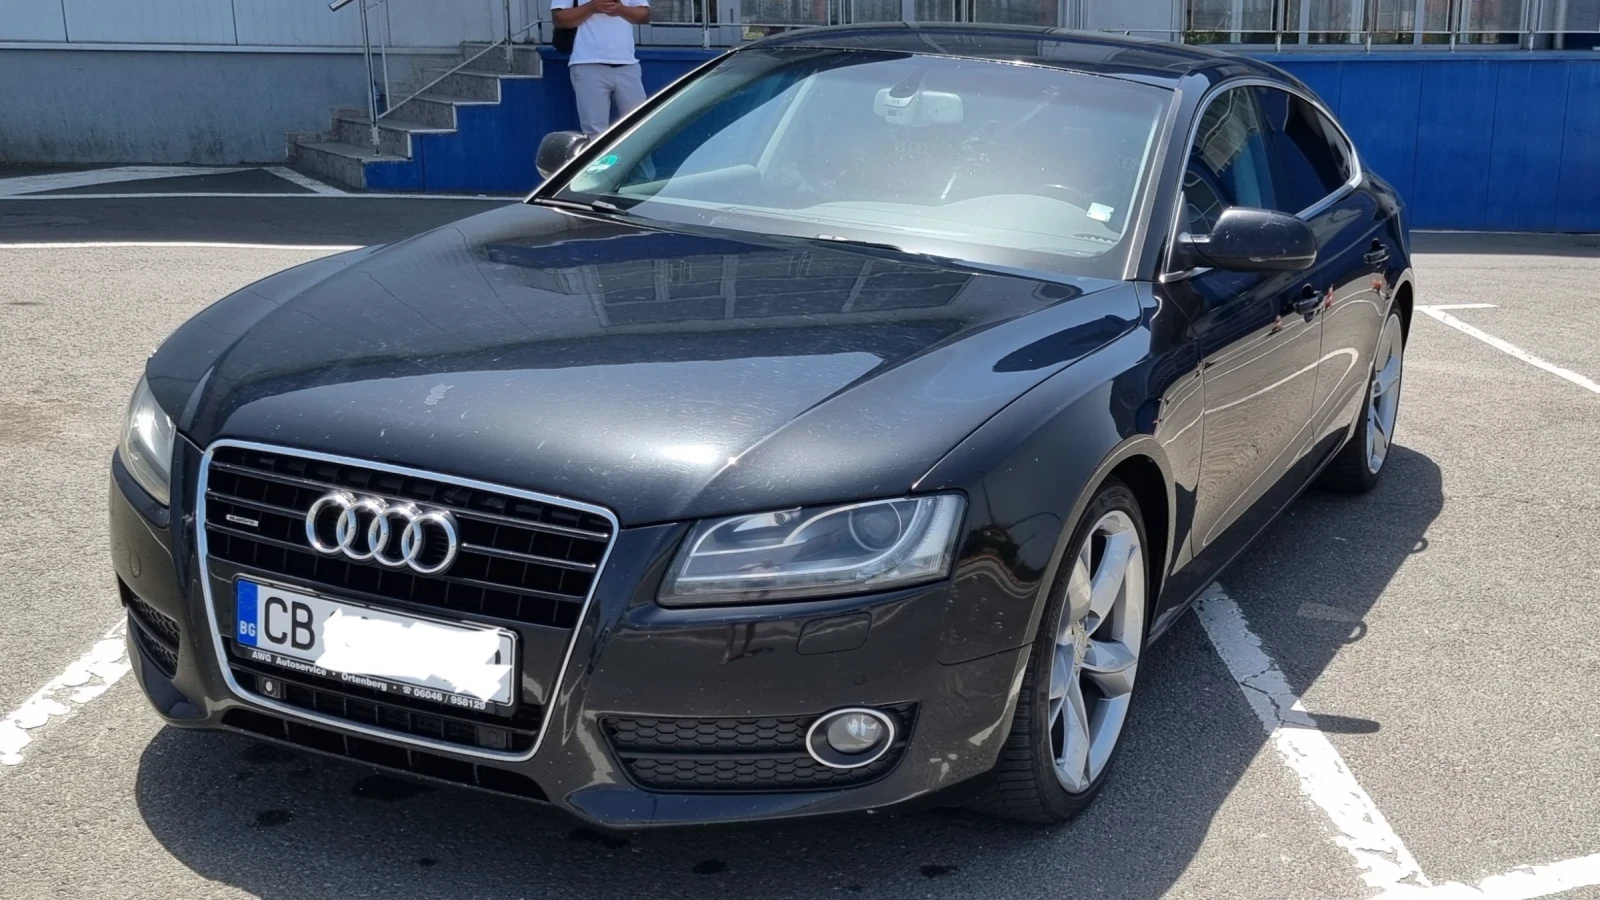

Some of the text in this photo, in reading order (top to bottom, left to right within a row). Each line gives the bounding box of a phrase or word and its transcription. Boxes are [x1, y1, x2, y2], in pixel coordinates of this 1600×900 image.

[240, 620, 256, 637] BG
[264, 596, 315, 651] CB
[252, 650, 272, 663] AWG
[276, 656, 327, 676] Autoservice
[341, 672, 387, 692] Ortenberg
[413, 688, 443, 702] 06046
[450, 695, 486, 710] 958129
